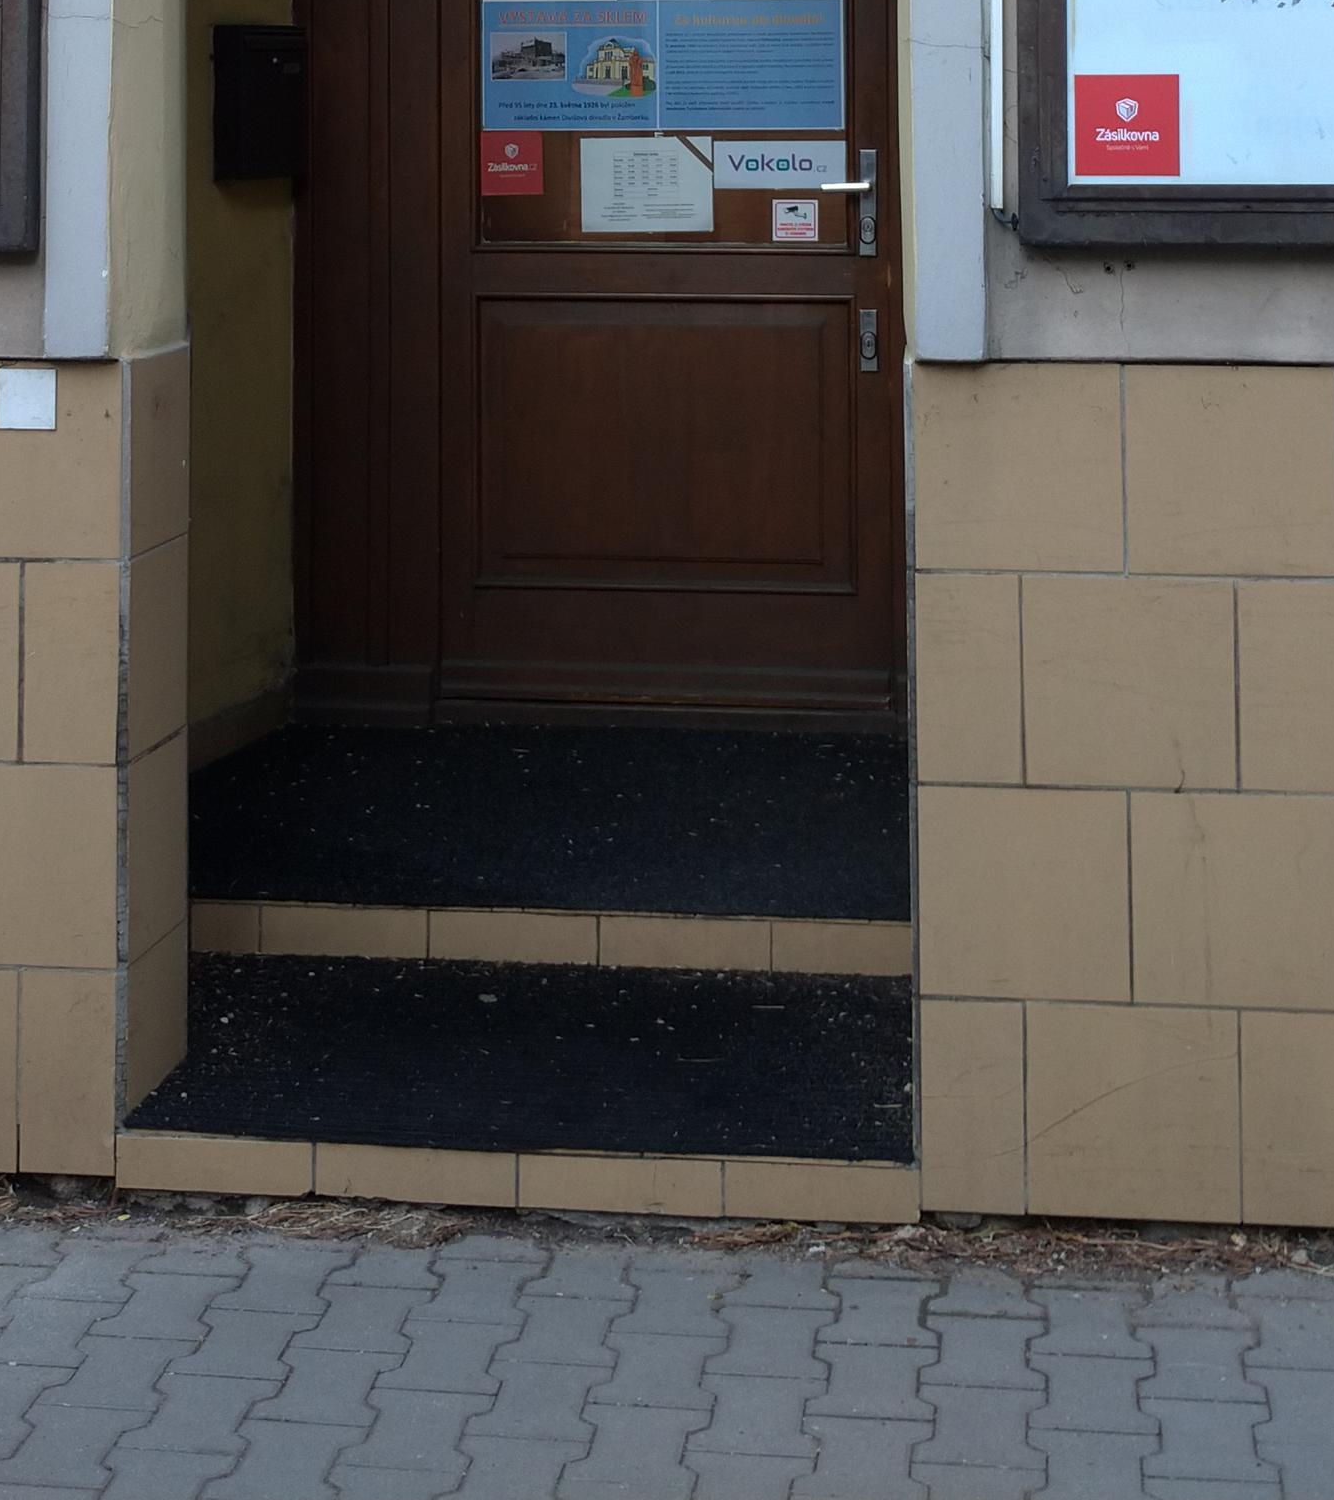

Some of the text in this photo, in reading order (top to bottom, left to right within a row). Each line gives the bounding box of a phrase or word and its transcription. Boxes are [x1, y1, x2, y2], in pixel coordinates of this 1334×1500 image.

[574, 10, 592, 22] ZA
[598, 9, 648, 22] SKLEM
[1095, 128, 1160, 142] Zásilkovna
